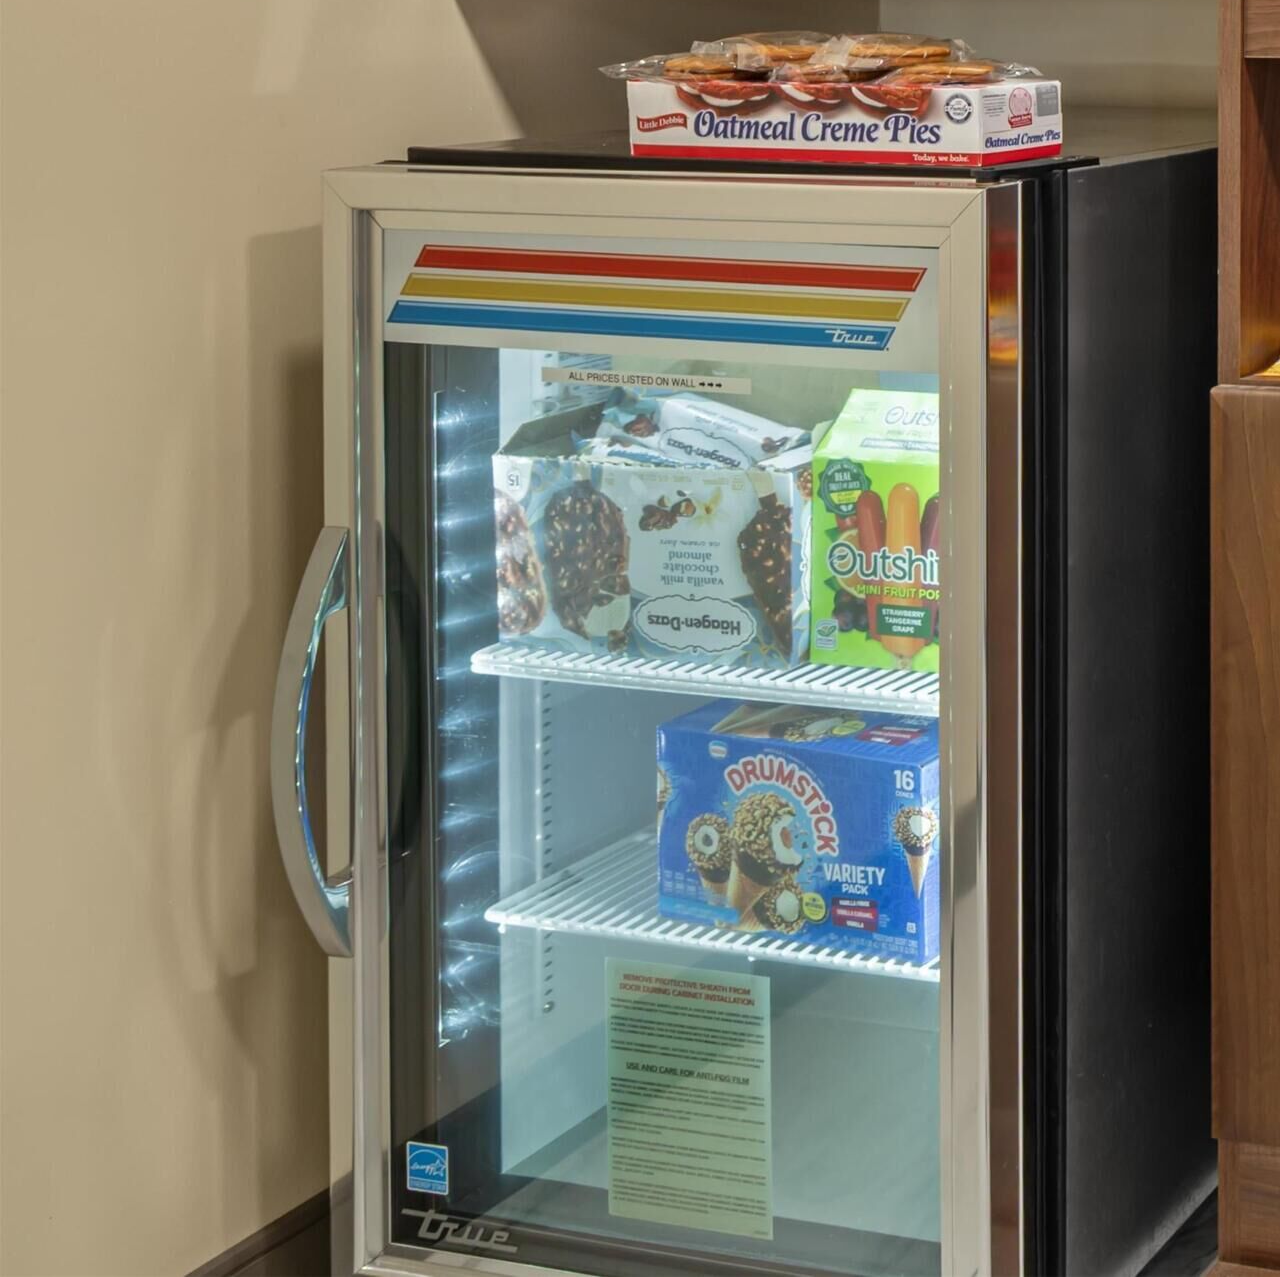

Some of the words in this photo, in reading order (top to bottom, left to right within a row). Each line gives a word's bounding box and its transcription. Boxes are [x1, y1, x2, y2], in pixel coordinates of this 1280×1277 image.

[693, 109, 796, 142] Oatmeal
[801, 112, 879, 143] Creme
[884, 114, 941, 144] Pies
[985, 134, 1021, 149] Oatmeal
[1021, 132, 1045, 145] Creme
[1046, 129, 1061, 141] Pies
[913, 153, 937, 163] Today,
[949, 153, 970, 163] bake.
[569, 372, 584, 381] ALL
[587, 372, 620, 383] PRICES
[622, 375, 654, 385] LISTED
[655, 376, 669, 386] ON
[671, 378, 696, 387] WALL
[507, 473, 521, 487] 15
[667, 550, 713, 561] almond
[662, 561, 721, 576] chocolate
[658, 573, 682, 586] milk
[683, 576, 725, 588] vanilla
[647, 610, 742, 637] Häagen-Dazs
[894, 769, 914, 791] 16
[726, 755, 839, 856] DRUMSTICK
[823, 863, 886, 886] VARIETY
[841, 884, 869, 896] PACK
